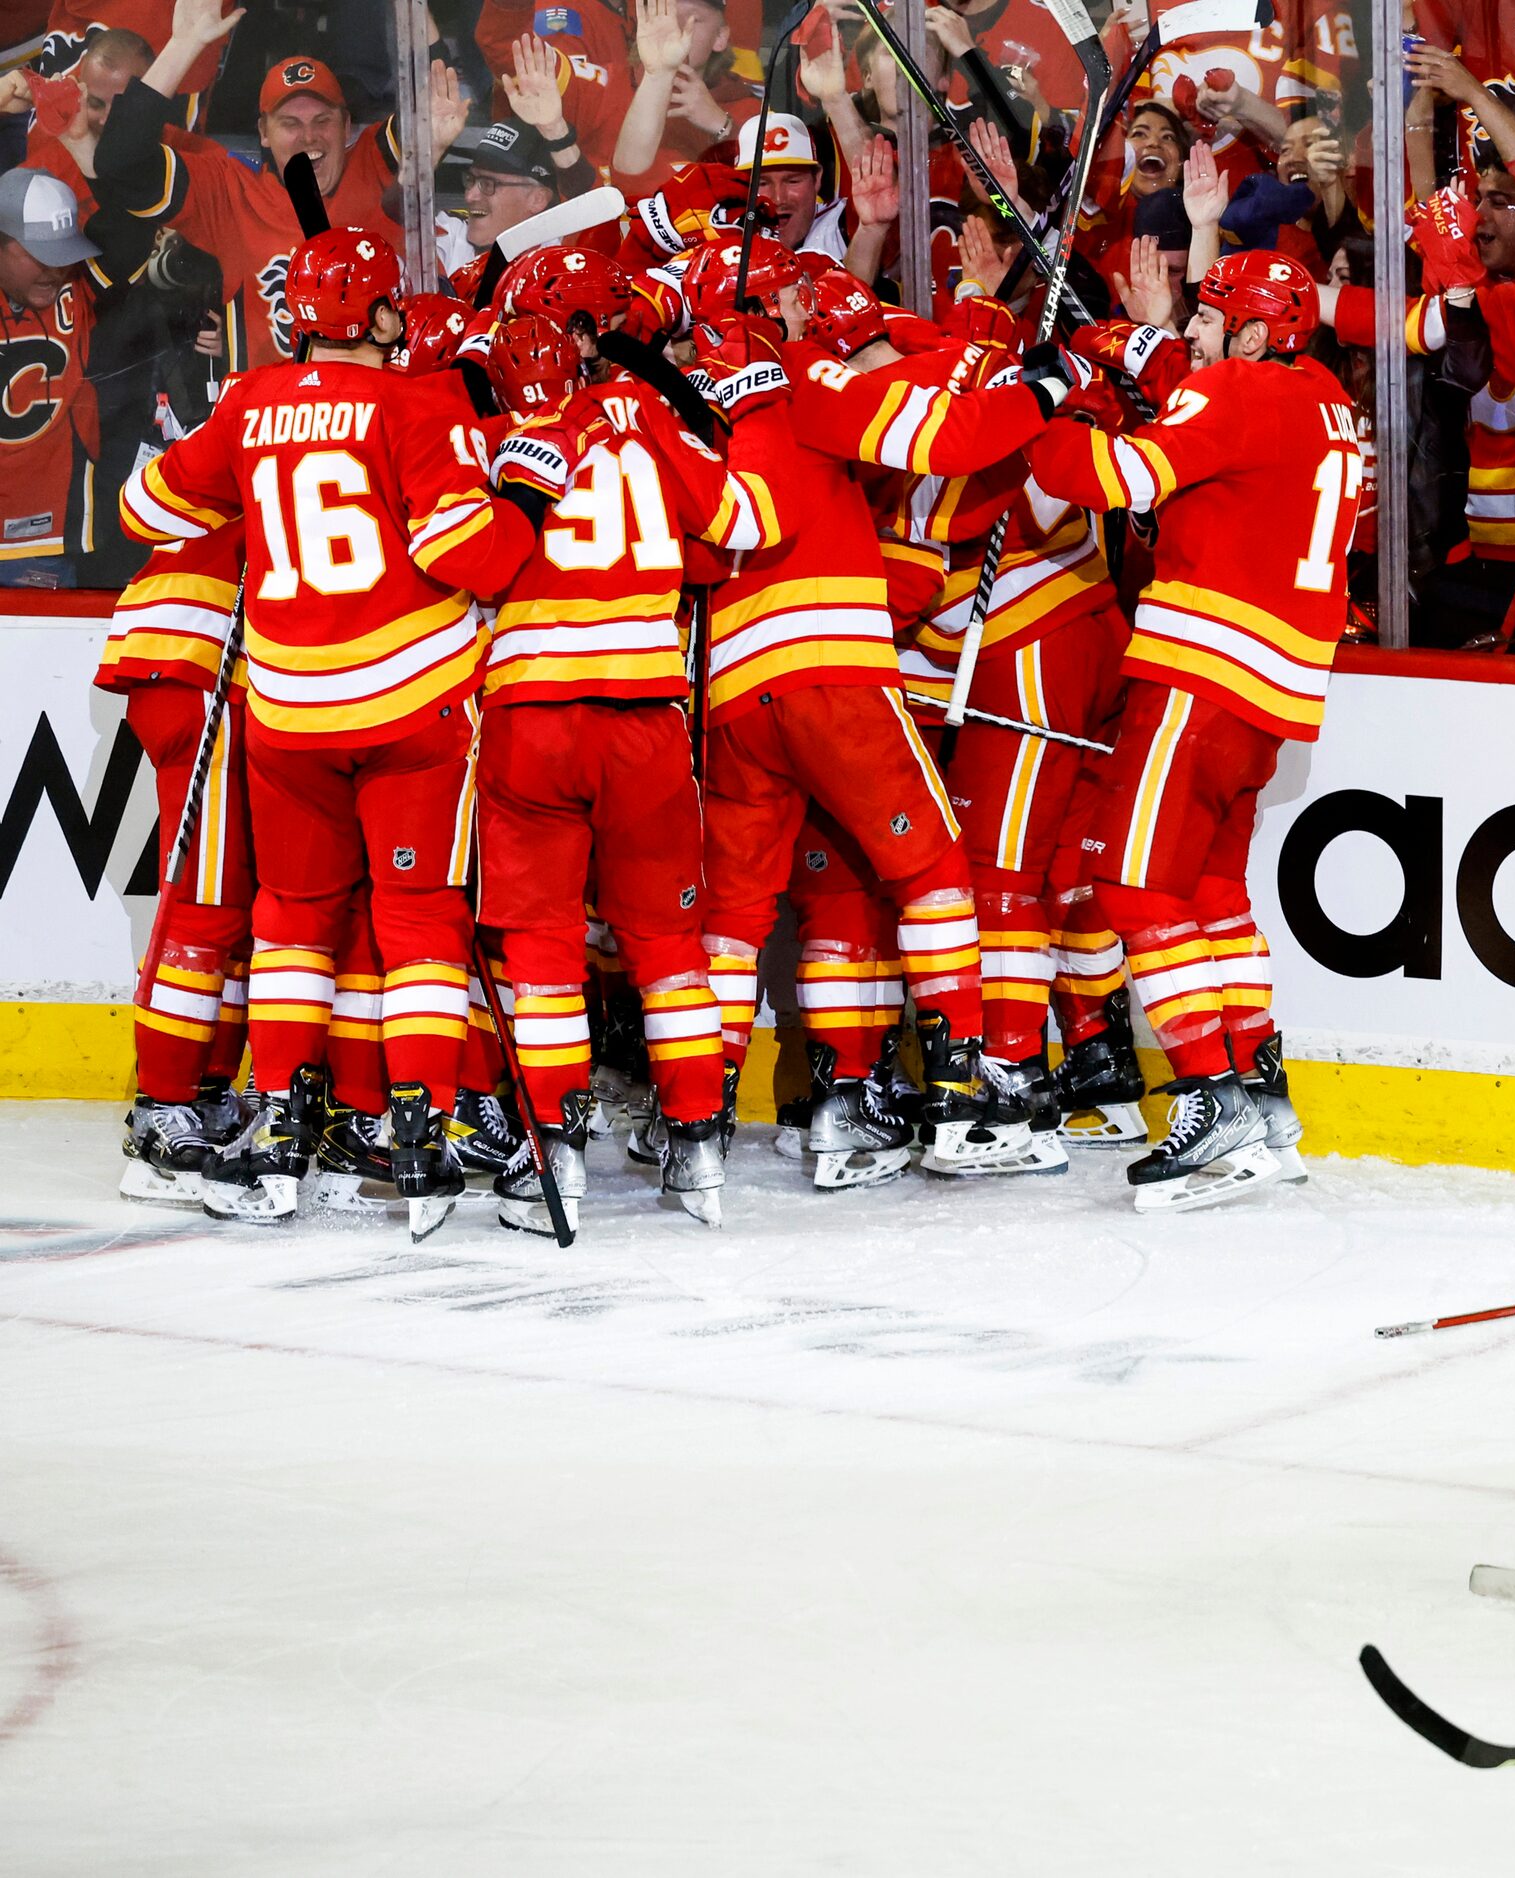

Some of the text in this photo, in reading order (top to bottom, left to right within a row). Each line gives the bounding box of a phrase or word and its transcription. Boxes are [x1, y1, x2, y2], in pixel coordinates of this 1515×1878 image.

[1314, 14, 1360, 58] 12
[297, 303, 318, 322] 16
[845, 291, 869, 312] 26
[522, 382, 548, 404] 91
[242, 401, 377, 449] ZADOROV
[543, 439, 684, 572] 91
[251, 449, 387, 602] 16
[865, 1123, 893, 1142] BAUER
[472, 1138, 507, 1159] BAUER
